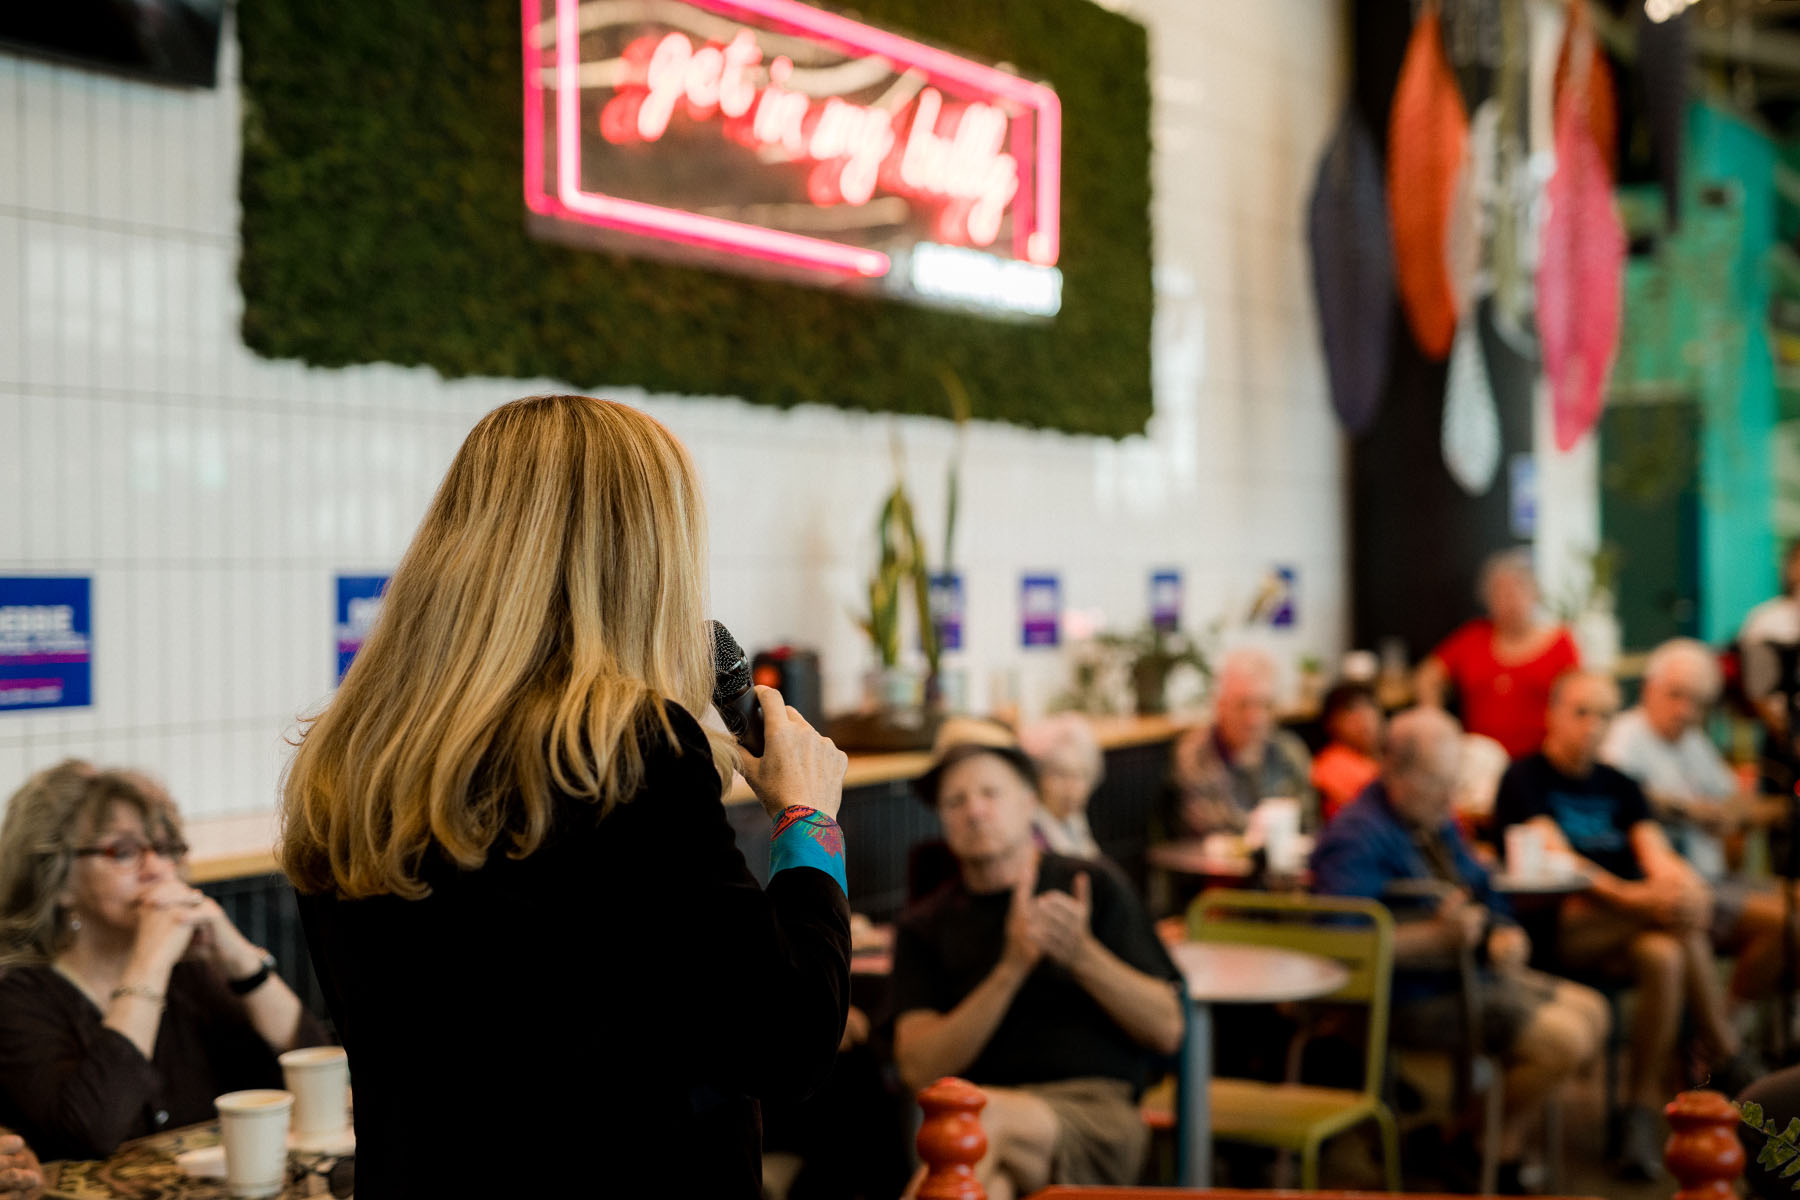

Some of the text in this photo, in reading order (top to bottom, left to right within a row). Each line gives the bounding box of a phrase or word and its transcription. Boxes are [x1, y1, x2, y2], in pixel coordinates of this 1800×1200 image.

[638, 28, 762, 141] get
[753, 55, 809, 152] in
[809, 97, 895, 205] my
